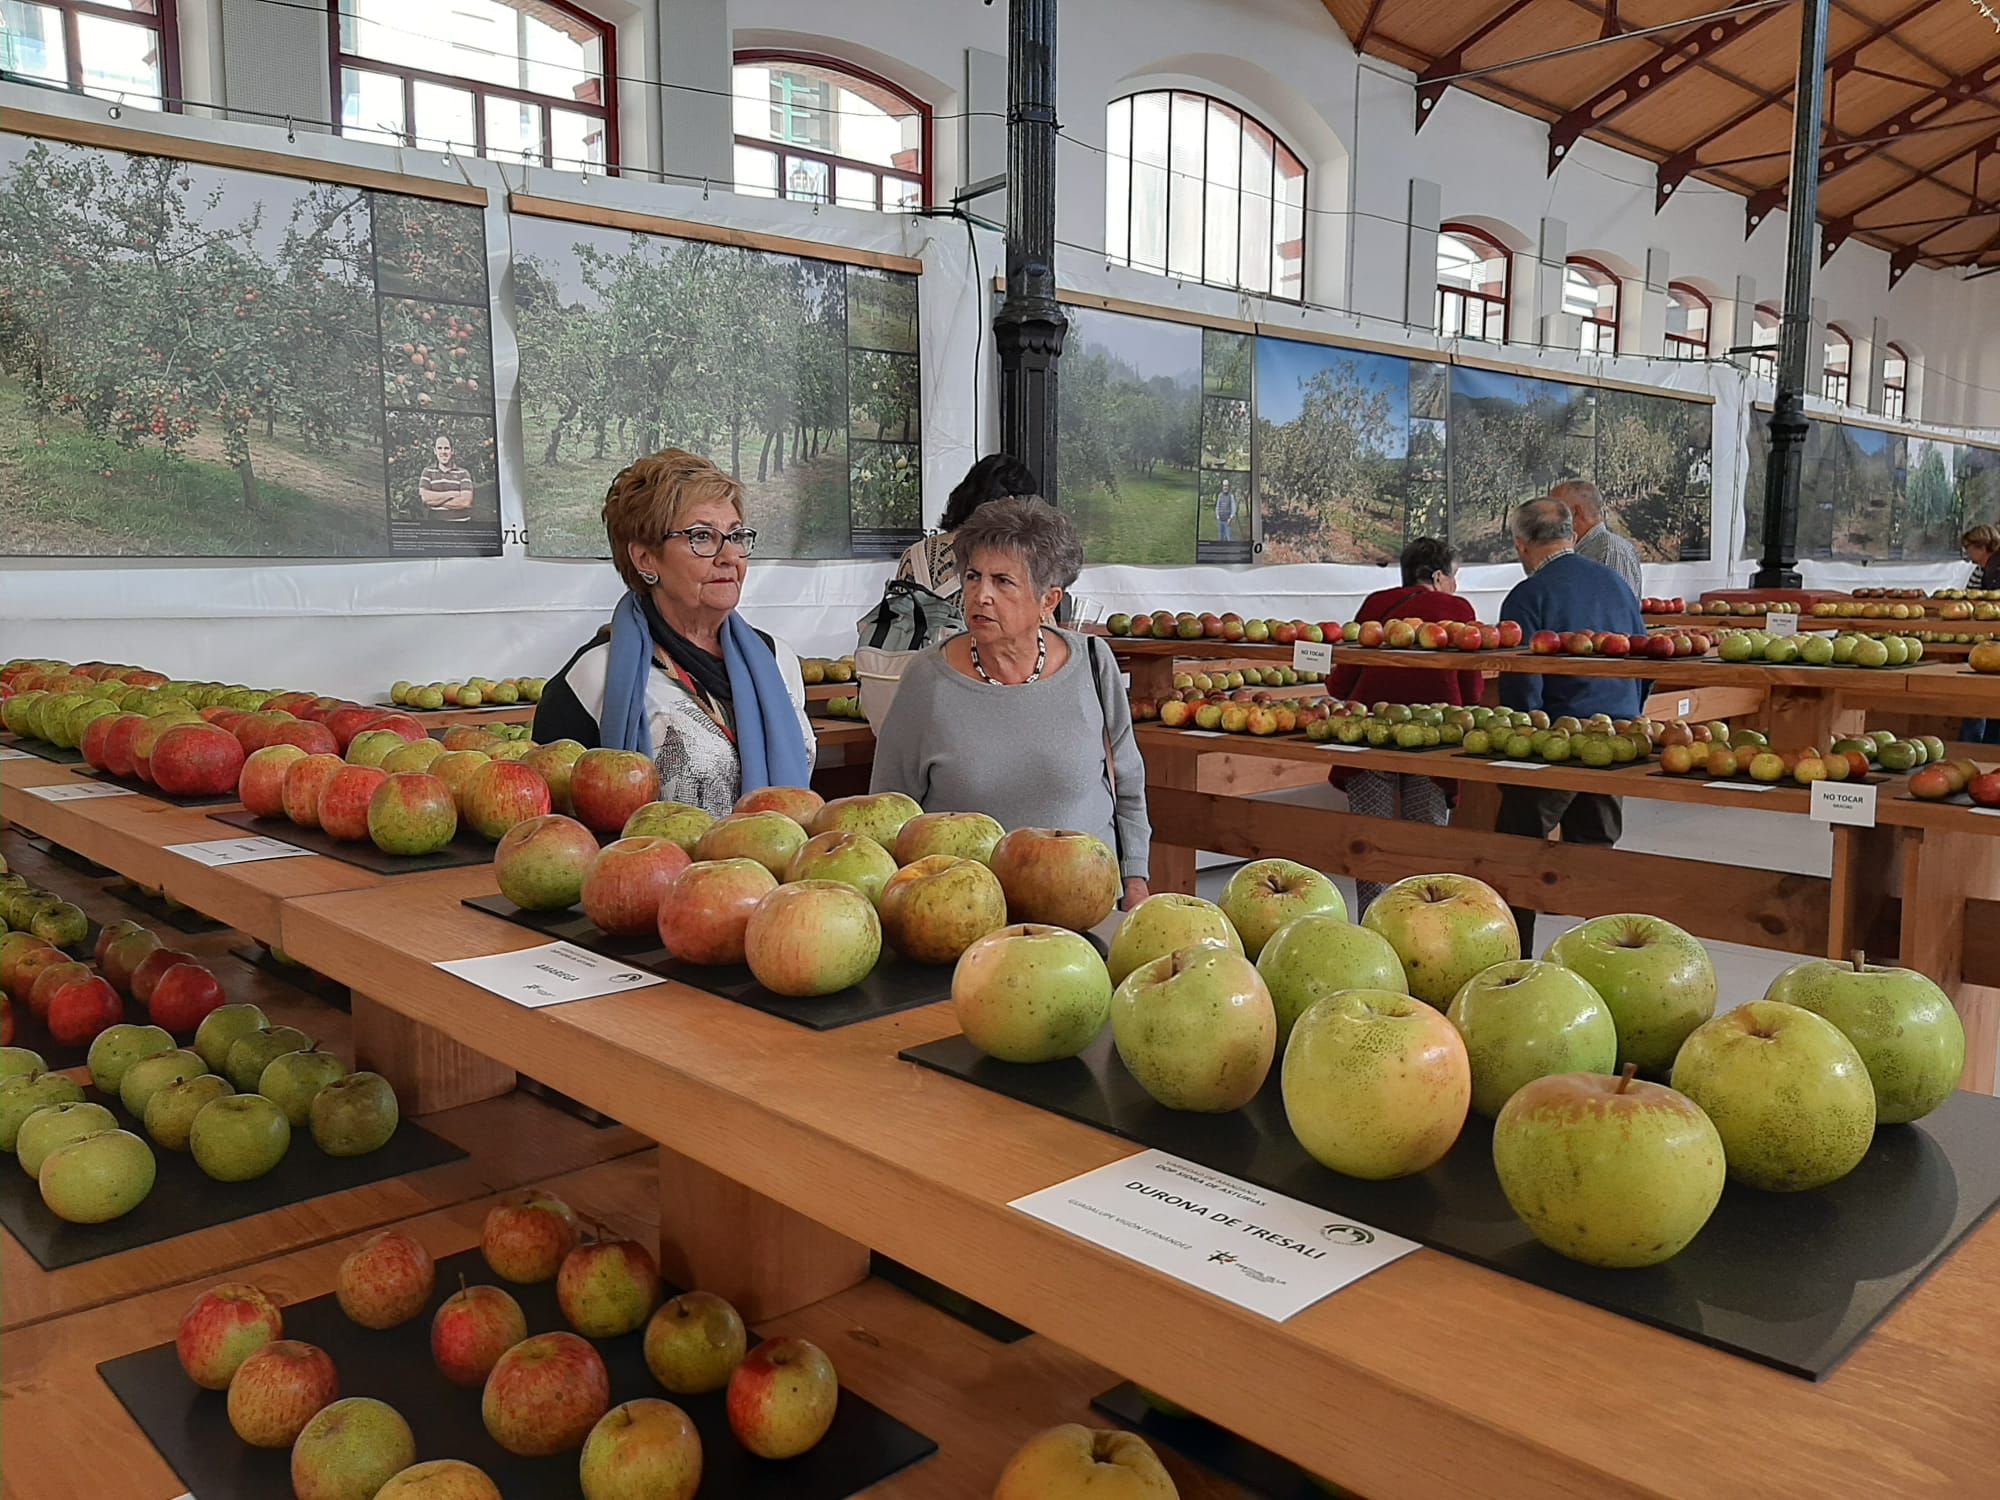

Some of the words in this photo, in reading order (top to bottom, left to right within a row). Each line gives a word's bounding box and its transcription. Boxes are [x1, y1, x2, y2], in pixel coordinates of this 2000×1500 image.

[1837, 794, 1864, 803] TOCAR
[1155, 1164, 1177, 1173] DOP
[1176, 1172, 1204, 1184] SIDRA
[1205, 1182, 1219, 1190] DE
[1218, 1187, 1268, 1207] ASTURIAS
[1125, 1181, 1209, 1216] DURONA
[1209, 1212, 1243, 1228] DE
[1242, 1224, 1328, 1260] TRESALI
